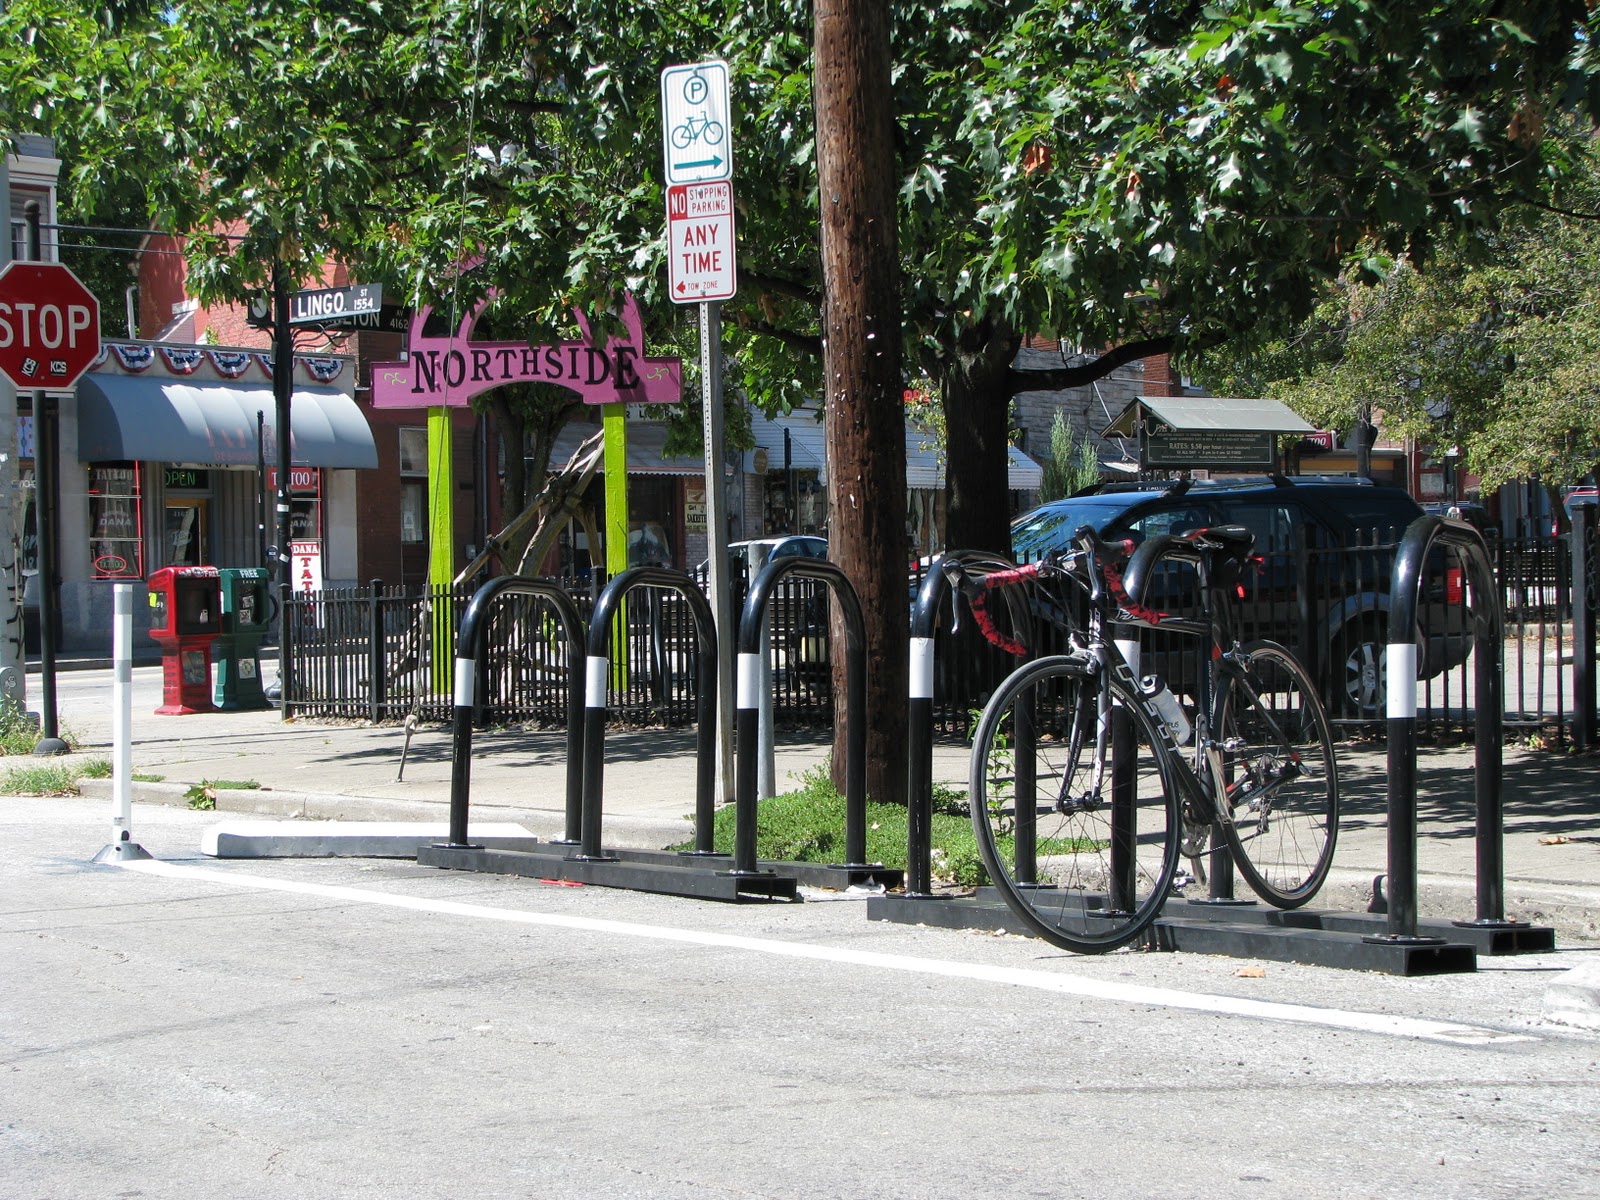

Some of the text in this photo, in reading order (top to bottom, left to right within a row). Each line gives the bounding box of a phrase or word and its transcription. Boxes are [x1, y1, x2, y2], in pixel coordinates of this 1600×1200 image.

[689, 186, 728, 200] STOPPING
[671, 192, 687, 214] NO
[691, 200, 726, 213] PARKING
[684, 223, 719, 247] ANY
[682, 251, 722, 274] TIME
[688, 280, 719, 291] TOW ZONE
[360, 288, 368, 297] ST
[353, 297, 374, 311] 1554
[0, 302, 91, 349] STOP
[389, 318, 409, 330] 4162
[50, 360, 67, 373] KCS
[411, 346, 640, 394] NORTHSIDE
[271, 471, 310, 486] TTOO
[100, 518, 132, 526] DANA
[293, 544, 319, 554] DANA
[204, 569, 221, 578] FREE
[239, 569, 260, 579] FREE
